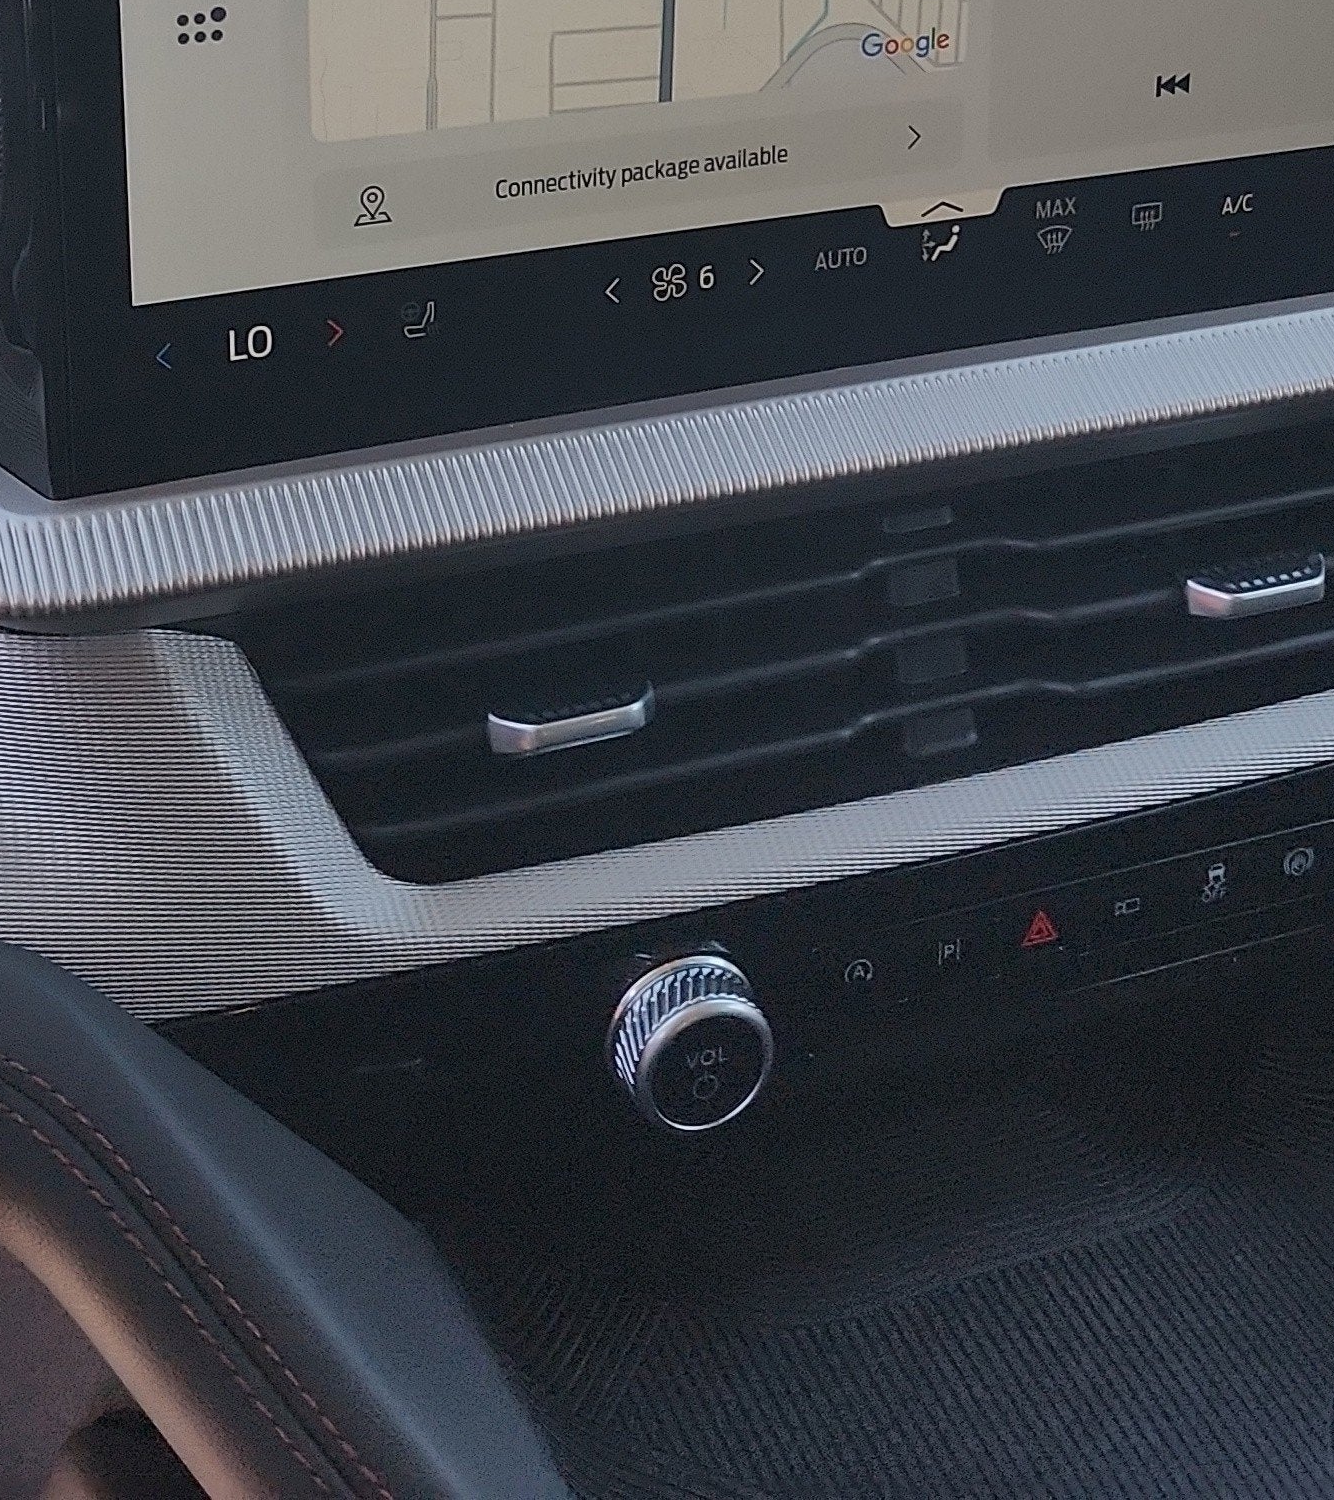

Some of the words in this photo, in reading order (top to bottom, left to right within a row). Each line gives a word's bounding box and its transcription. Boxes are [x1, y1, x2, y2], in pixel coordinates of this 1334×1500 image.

[861, 28, 951, 60] Google
[495, 166, 616, 199] Connectivity
[621, 158, 700, 186] package
[704, 145, 789, 173] available
[1036, 196, 1077, 219] MAX
[1221, 192, 1255, 216] A/C
[814, 246, 868, 272] AUTO
[698, 266, 715, 290] 6
[227, 325, 273, 362] LO
[687, 1046, 729, 1068] VOL
